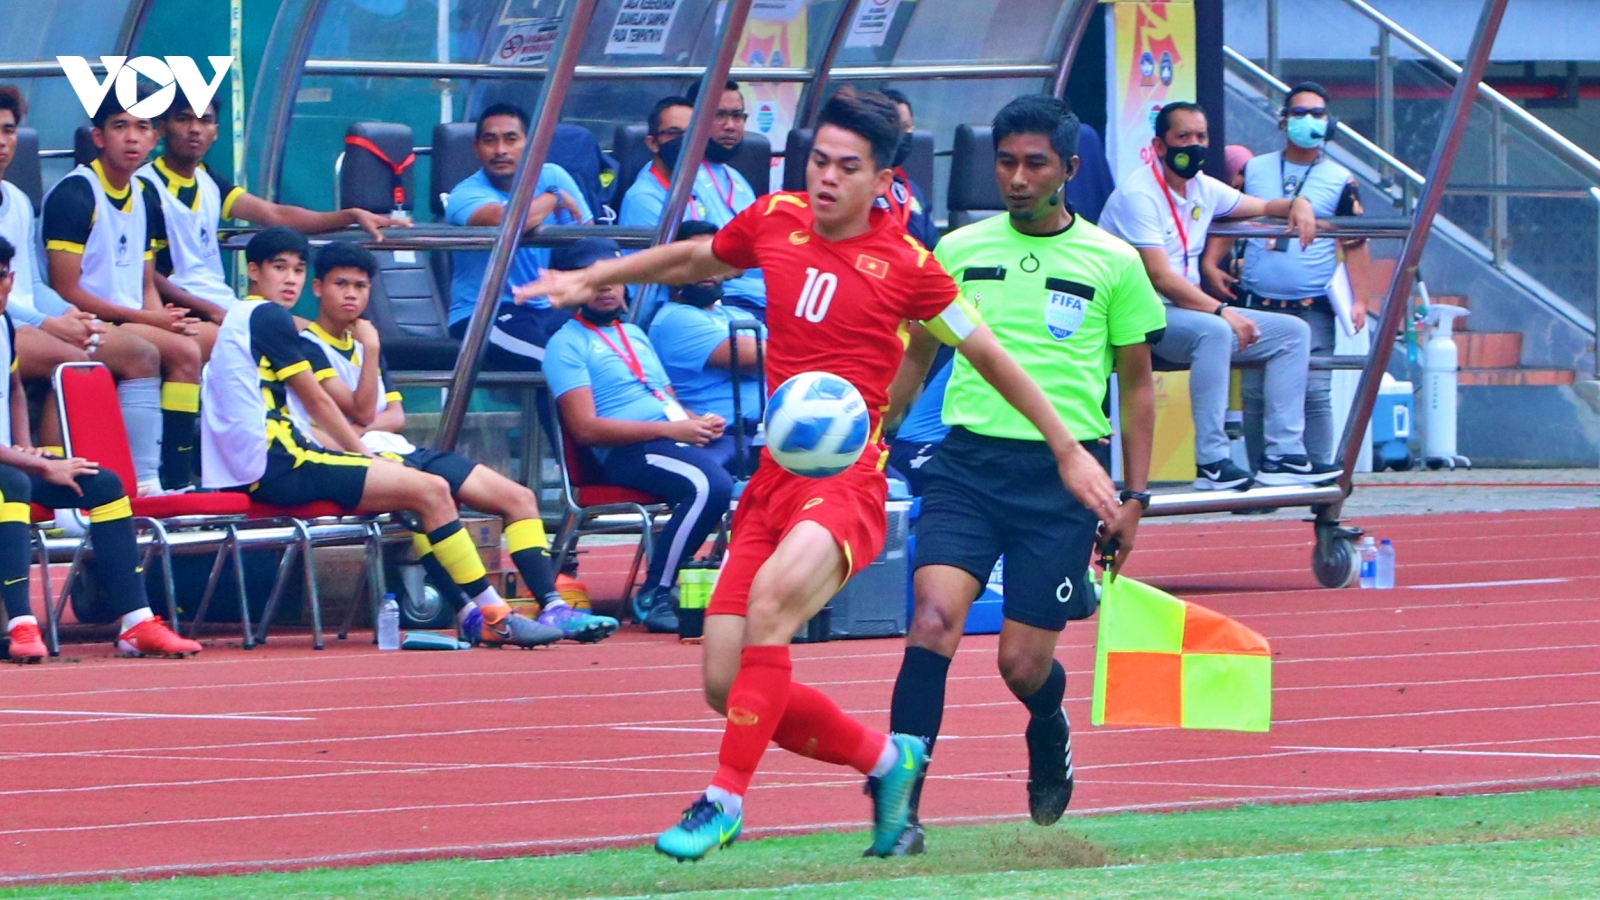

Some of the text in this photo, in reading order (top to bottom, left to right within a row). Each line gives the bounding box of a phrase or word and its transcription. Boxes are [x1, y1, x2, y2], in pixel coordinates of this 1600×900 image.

[794, 266, 838, 324] 10
[1052, 294, 1081, 310] FIFA
[1053, 328, 1067, 336] 2022
